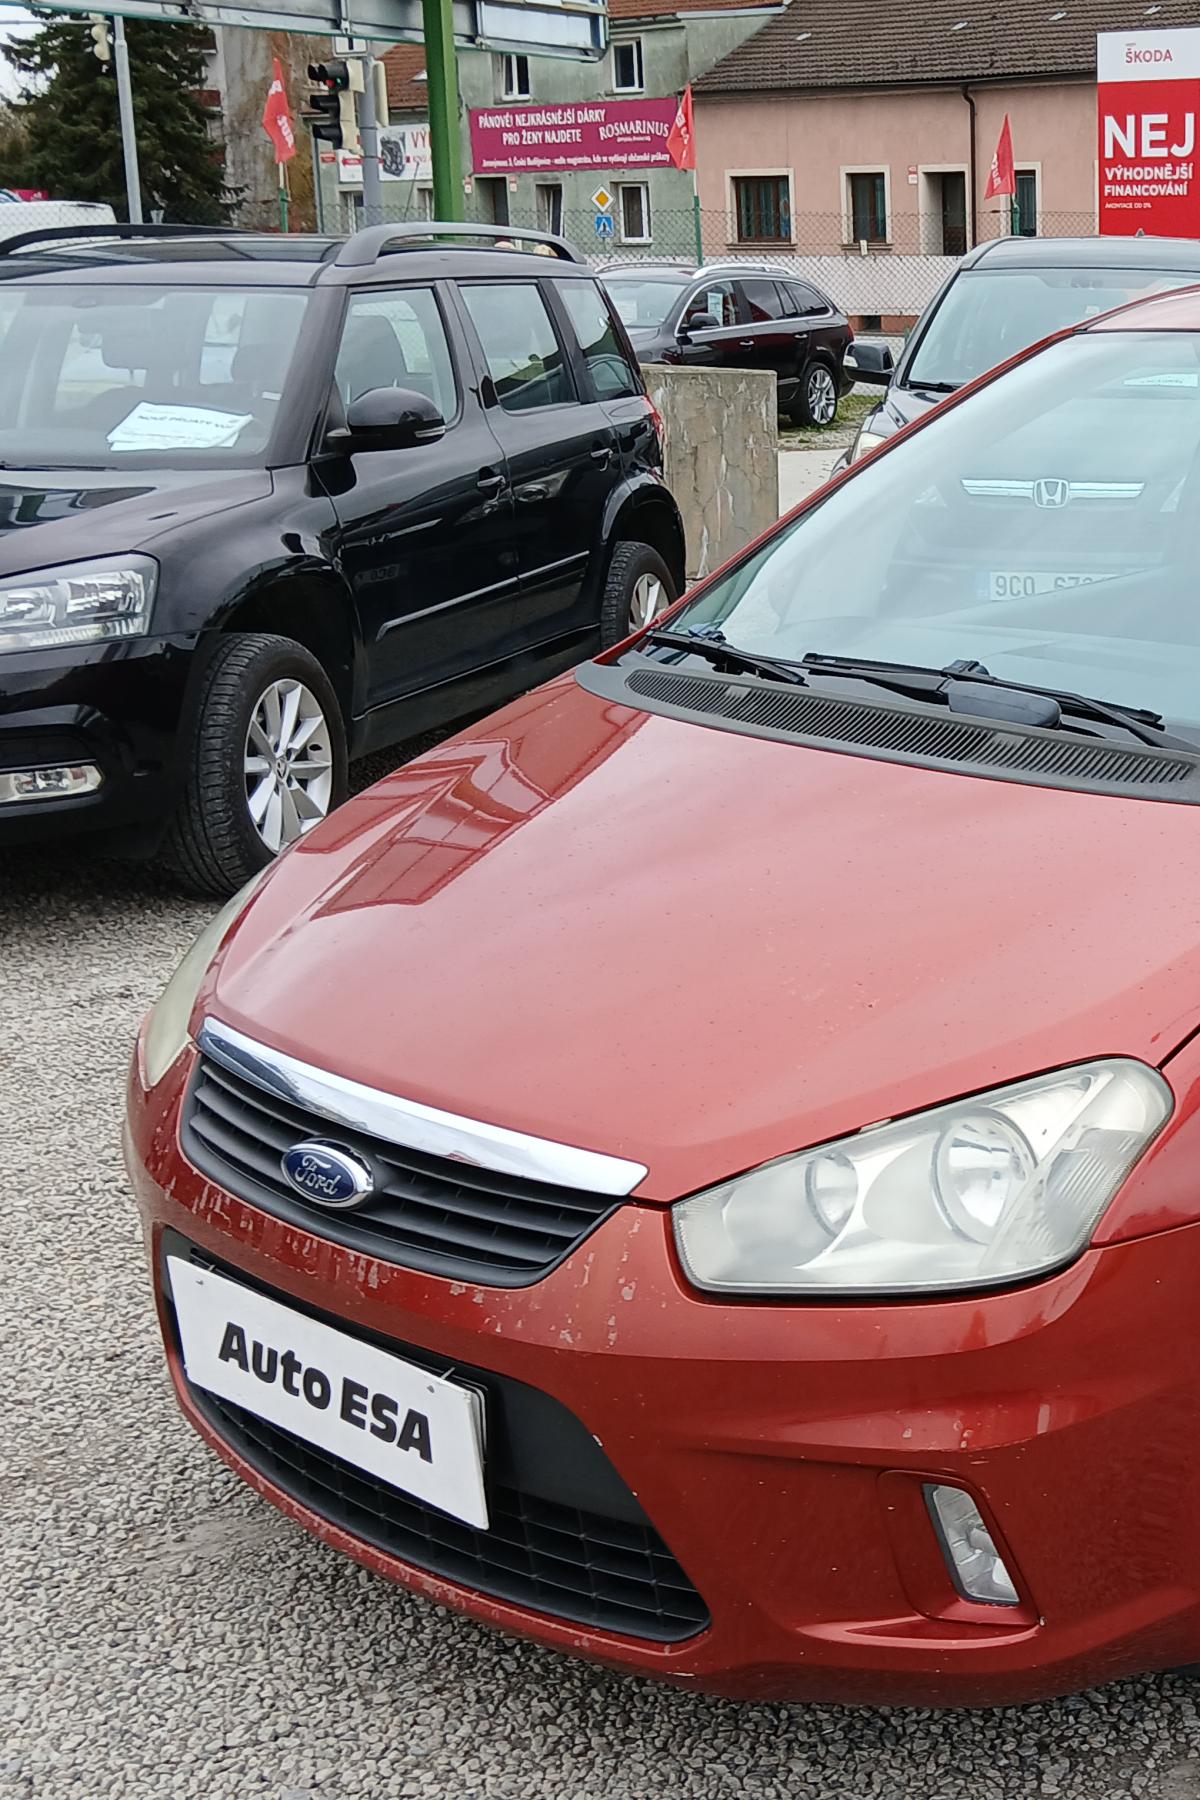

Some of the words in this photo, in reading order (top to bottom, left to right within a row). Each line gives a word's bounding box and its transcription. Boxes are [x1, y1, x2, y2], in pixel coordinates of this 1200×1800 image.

[1125, 48, 1173, 64] ŠKODA
[515, 108, 575, 127] NEJKRÁSNĚJŠÍ
[577, 107, 606, 124] DÁRKY
[502, 132, 520, 146] PRO
[522, 129, 542, 145] ŽENY
[544, 129, 582, 144] NAJDETE
[599, 120, 669, 140] ROSMARINUS
[1104, 113, 1195, 158] NEJ
[1105, 163, 1193, 180] VÝHODNĚJŠÍ
[1104, 181, 1188, 196] FINANCOVÁNÍ
[295, 1155, 341, 1195] Ford
[218, 1321, 331, 1410] Auto
[340, 1376, 433, 1464] ESA
